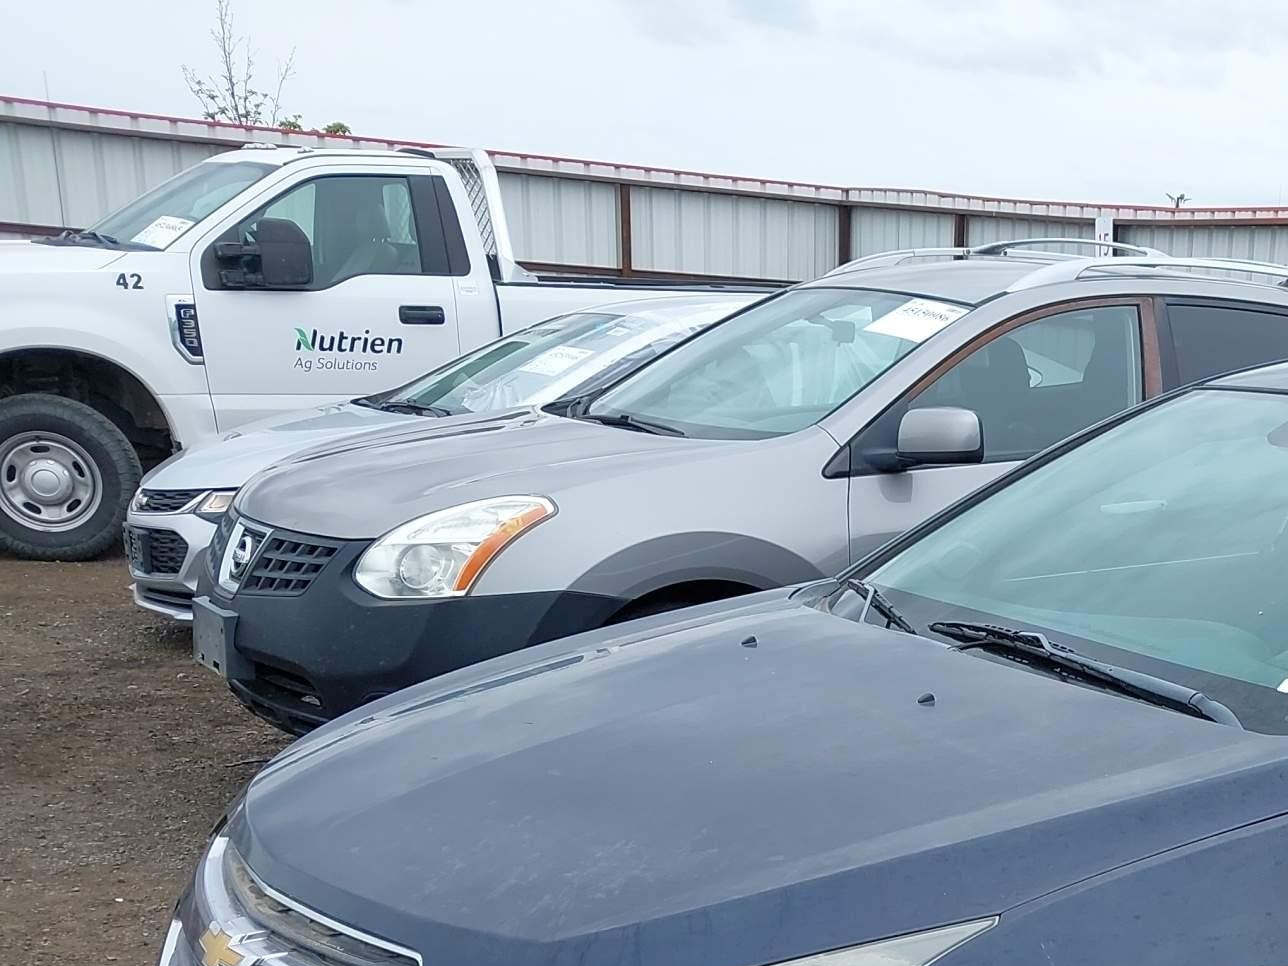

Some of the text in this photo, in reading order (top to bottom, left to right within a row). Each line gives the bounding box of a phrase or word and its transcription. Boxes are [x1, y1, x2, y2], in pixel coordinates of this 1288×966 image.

[1098, 232, 1110, 257] 15
[115, 272, 145, 290] 42
[294, 327, 404, 354] Nutrien
[294, 357, 378, 373] Ag Solutions
